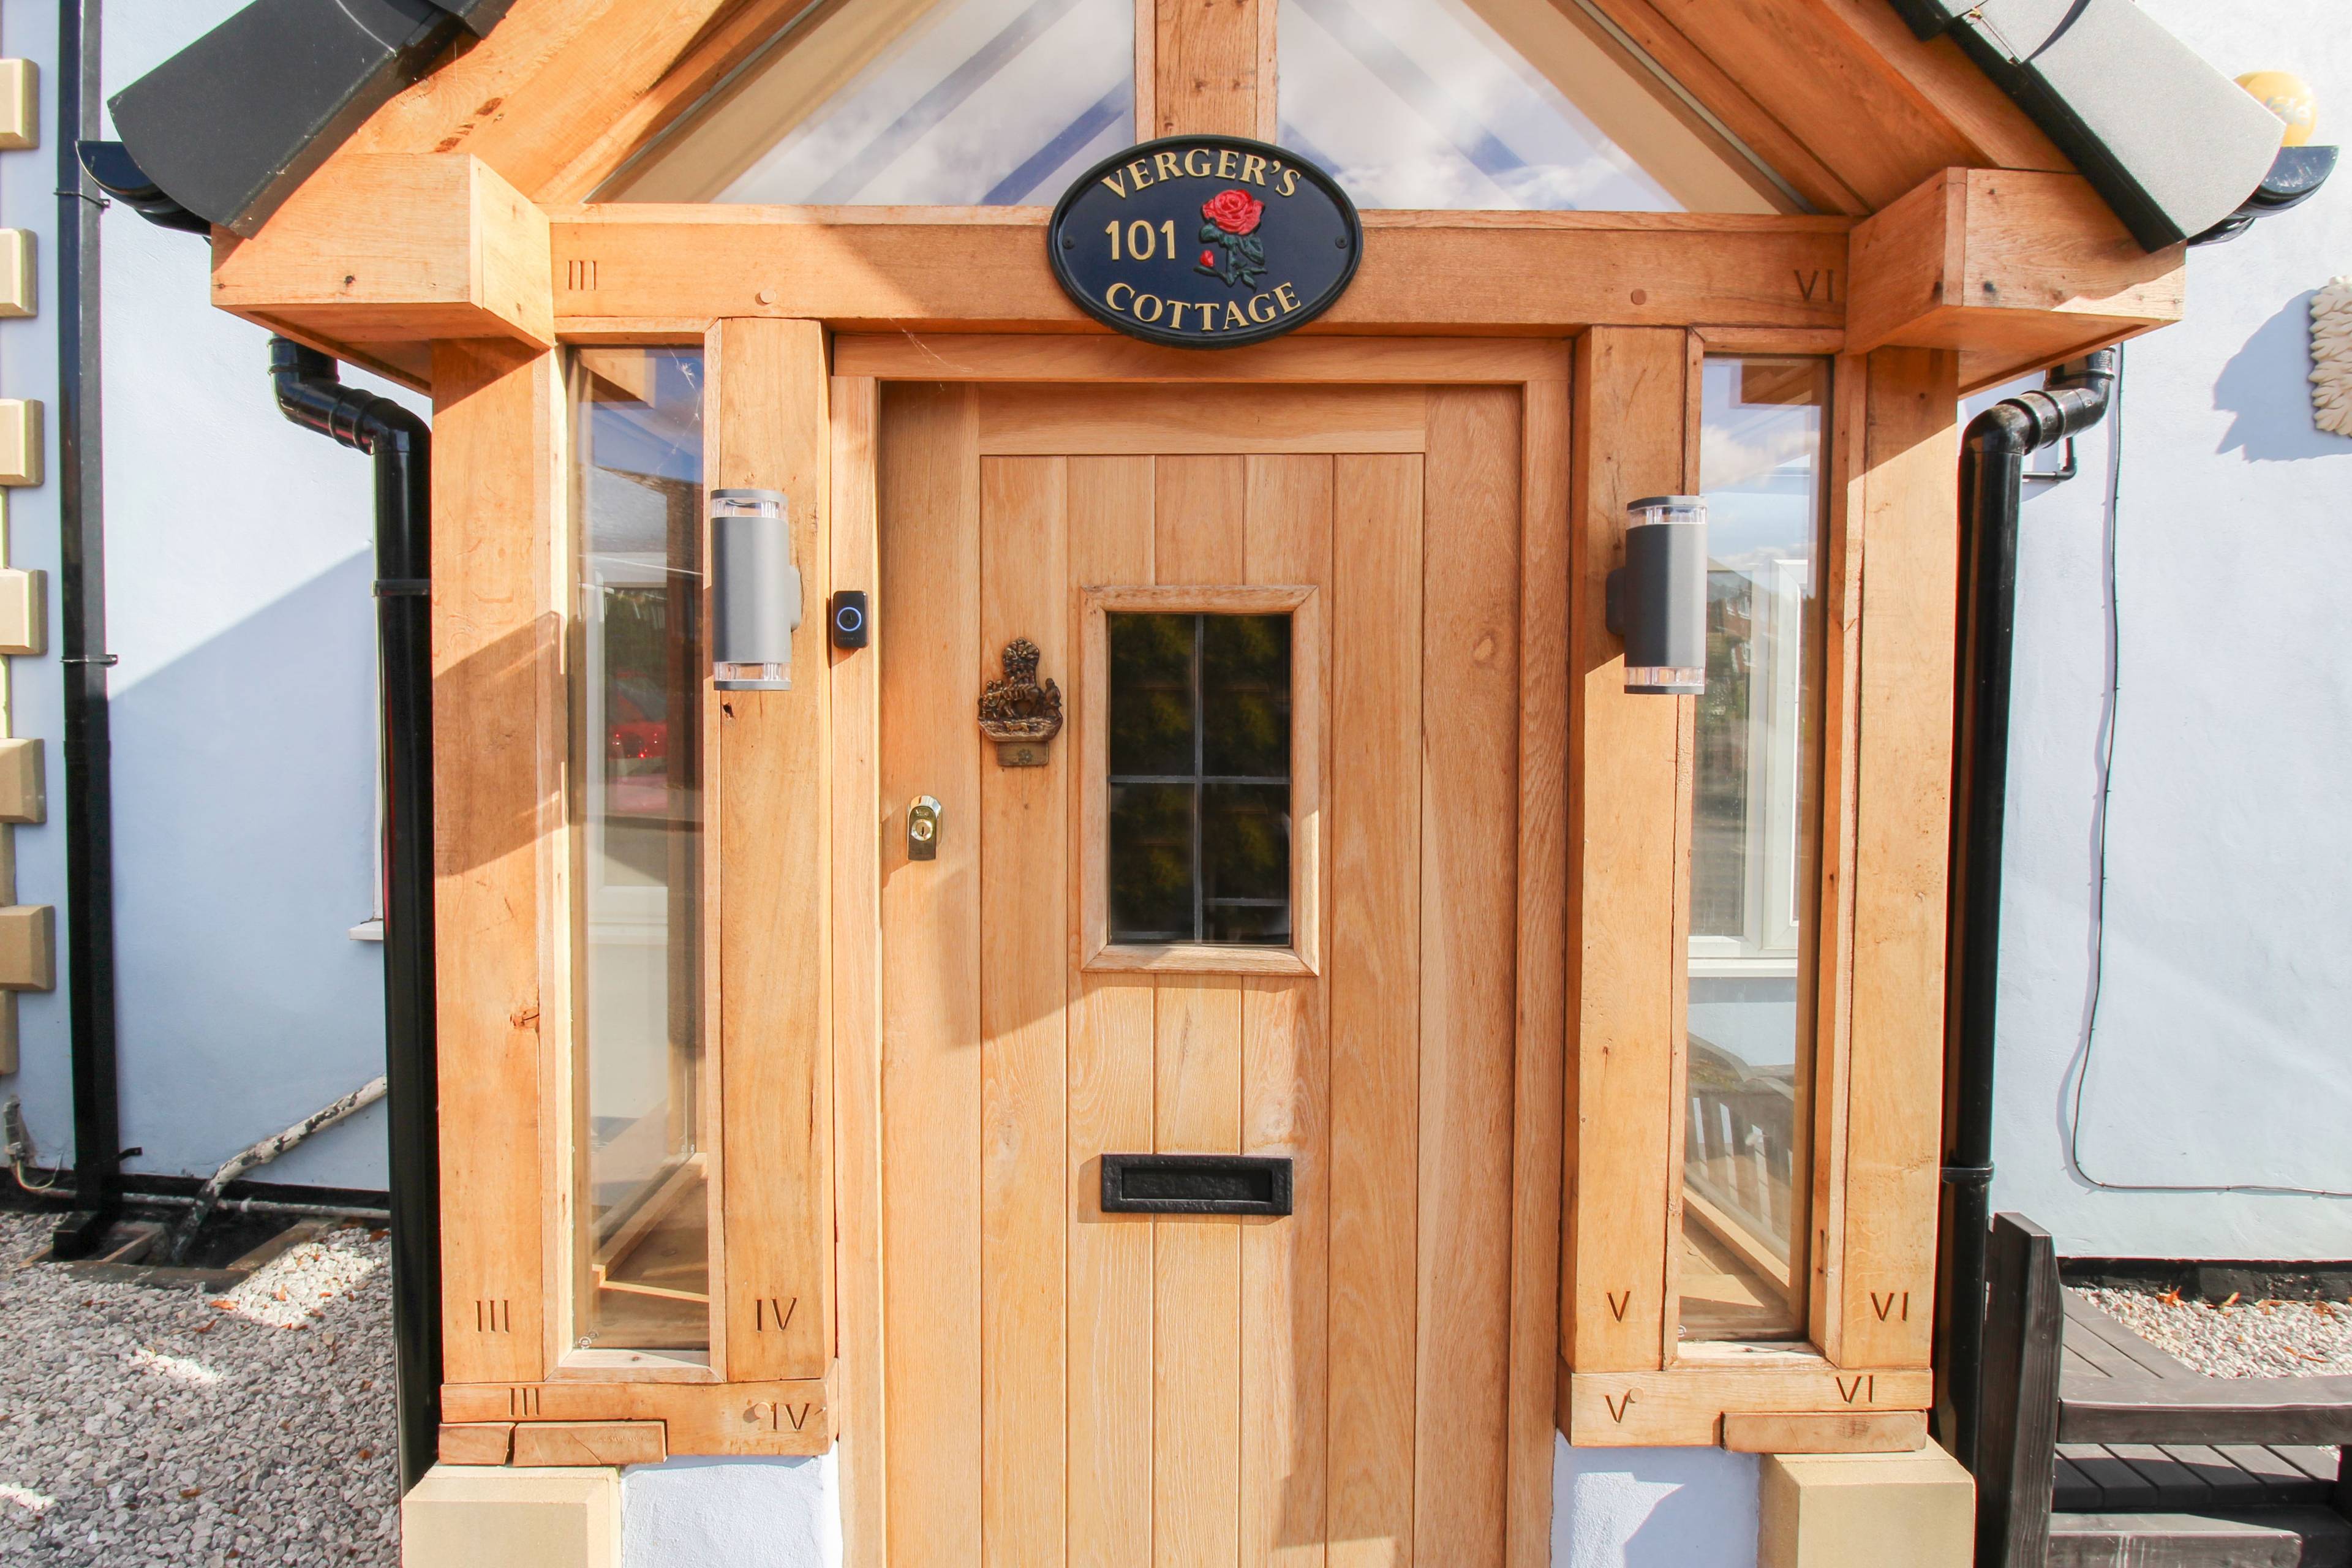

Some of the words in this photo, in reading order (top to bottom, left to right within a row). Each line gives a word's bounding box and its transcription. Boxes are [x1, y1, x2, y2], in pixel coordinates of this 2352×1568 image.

[1101, 148, 1302, 199] VERGER'S
[1105, 219, 1175, 261] 101
[1793, 269, 1834, 302] VI
[1106, 281, 1302, 333] COTTAGE
[475, 1299, 510, 1333] III
[756, 1297, 797, 1332] IV
[1605, 1291, 1630, 1322] V
[1870, 1291, 1909, 1321] VI
[510, 1387, 540, 1417] III
[1835, 1374, 1874, 1404] VI
[772, 1403, 810, 1432] IV
[1605, 1395, 1629, 1423] V
